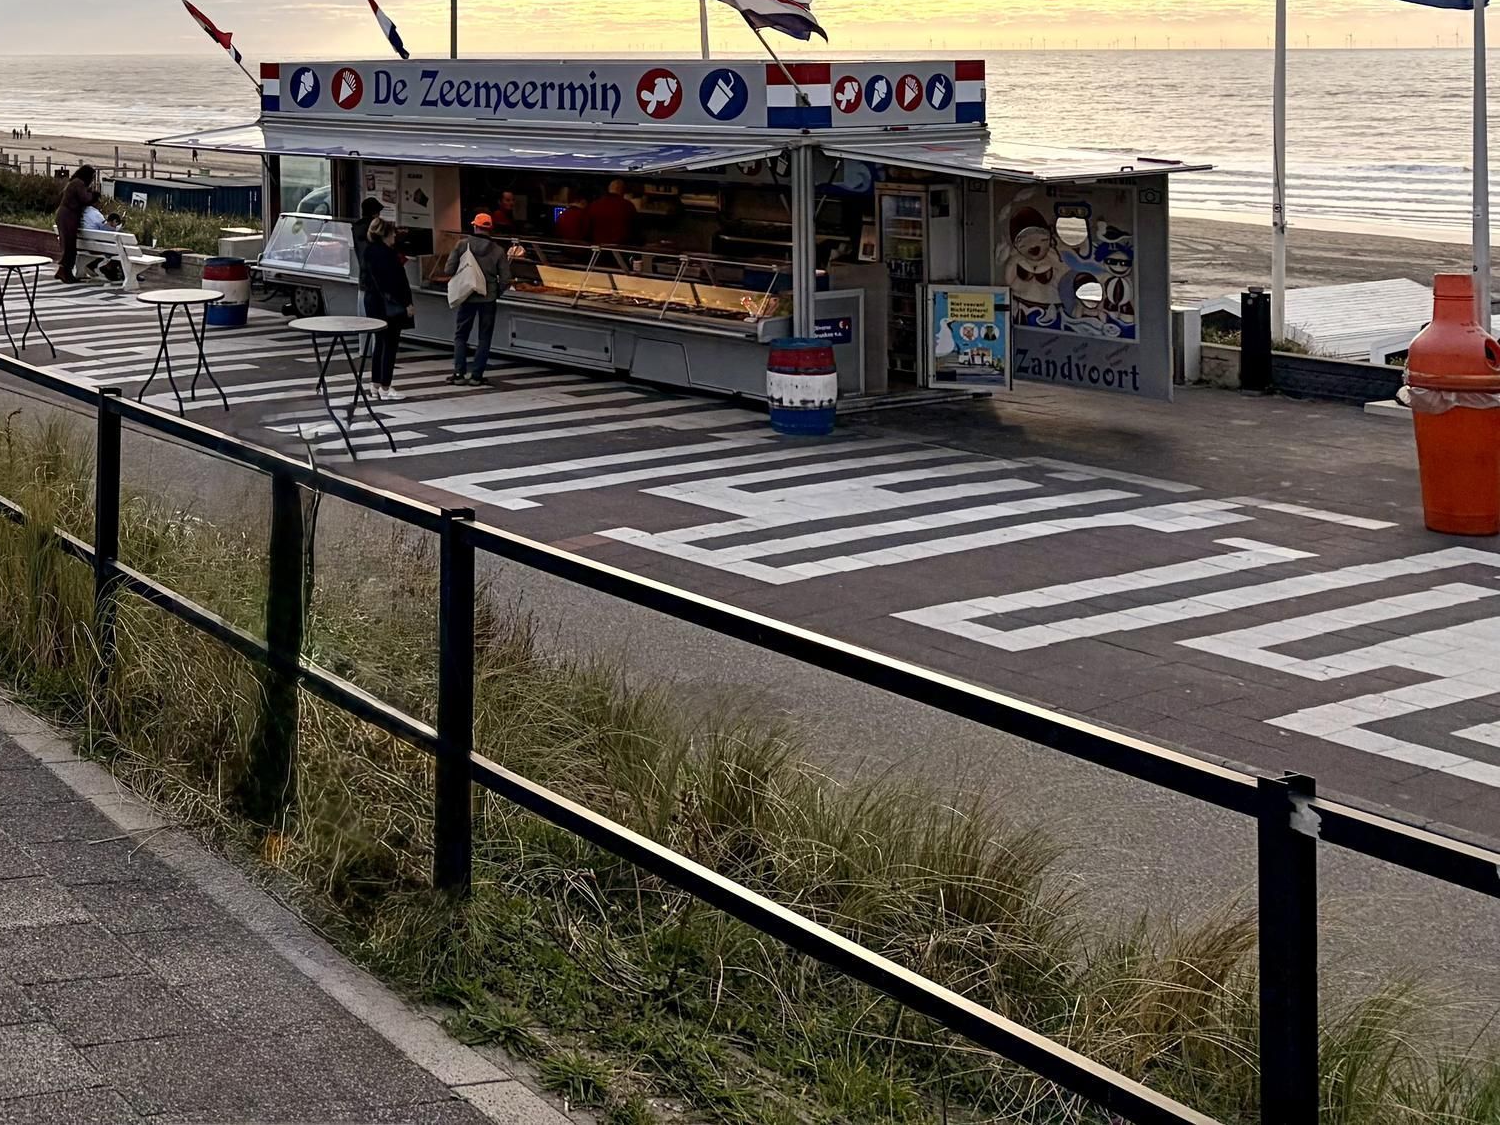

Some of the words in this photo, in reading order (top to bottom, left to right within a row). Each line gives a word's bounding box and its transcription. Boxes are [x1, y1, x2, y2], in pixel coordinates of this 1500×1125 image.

[373, 70, 409, 107] De
[419, 70, 621, 118] Zeemeermin
[1015, 348, 1140, 392] Zandvoort
